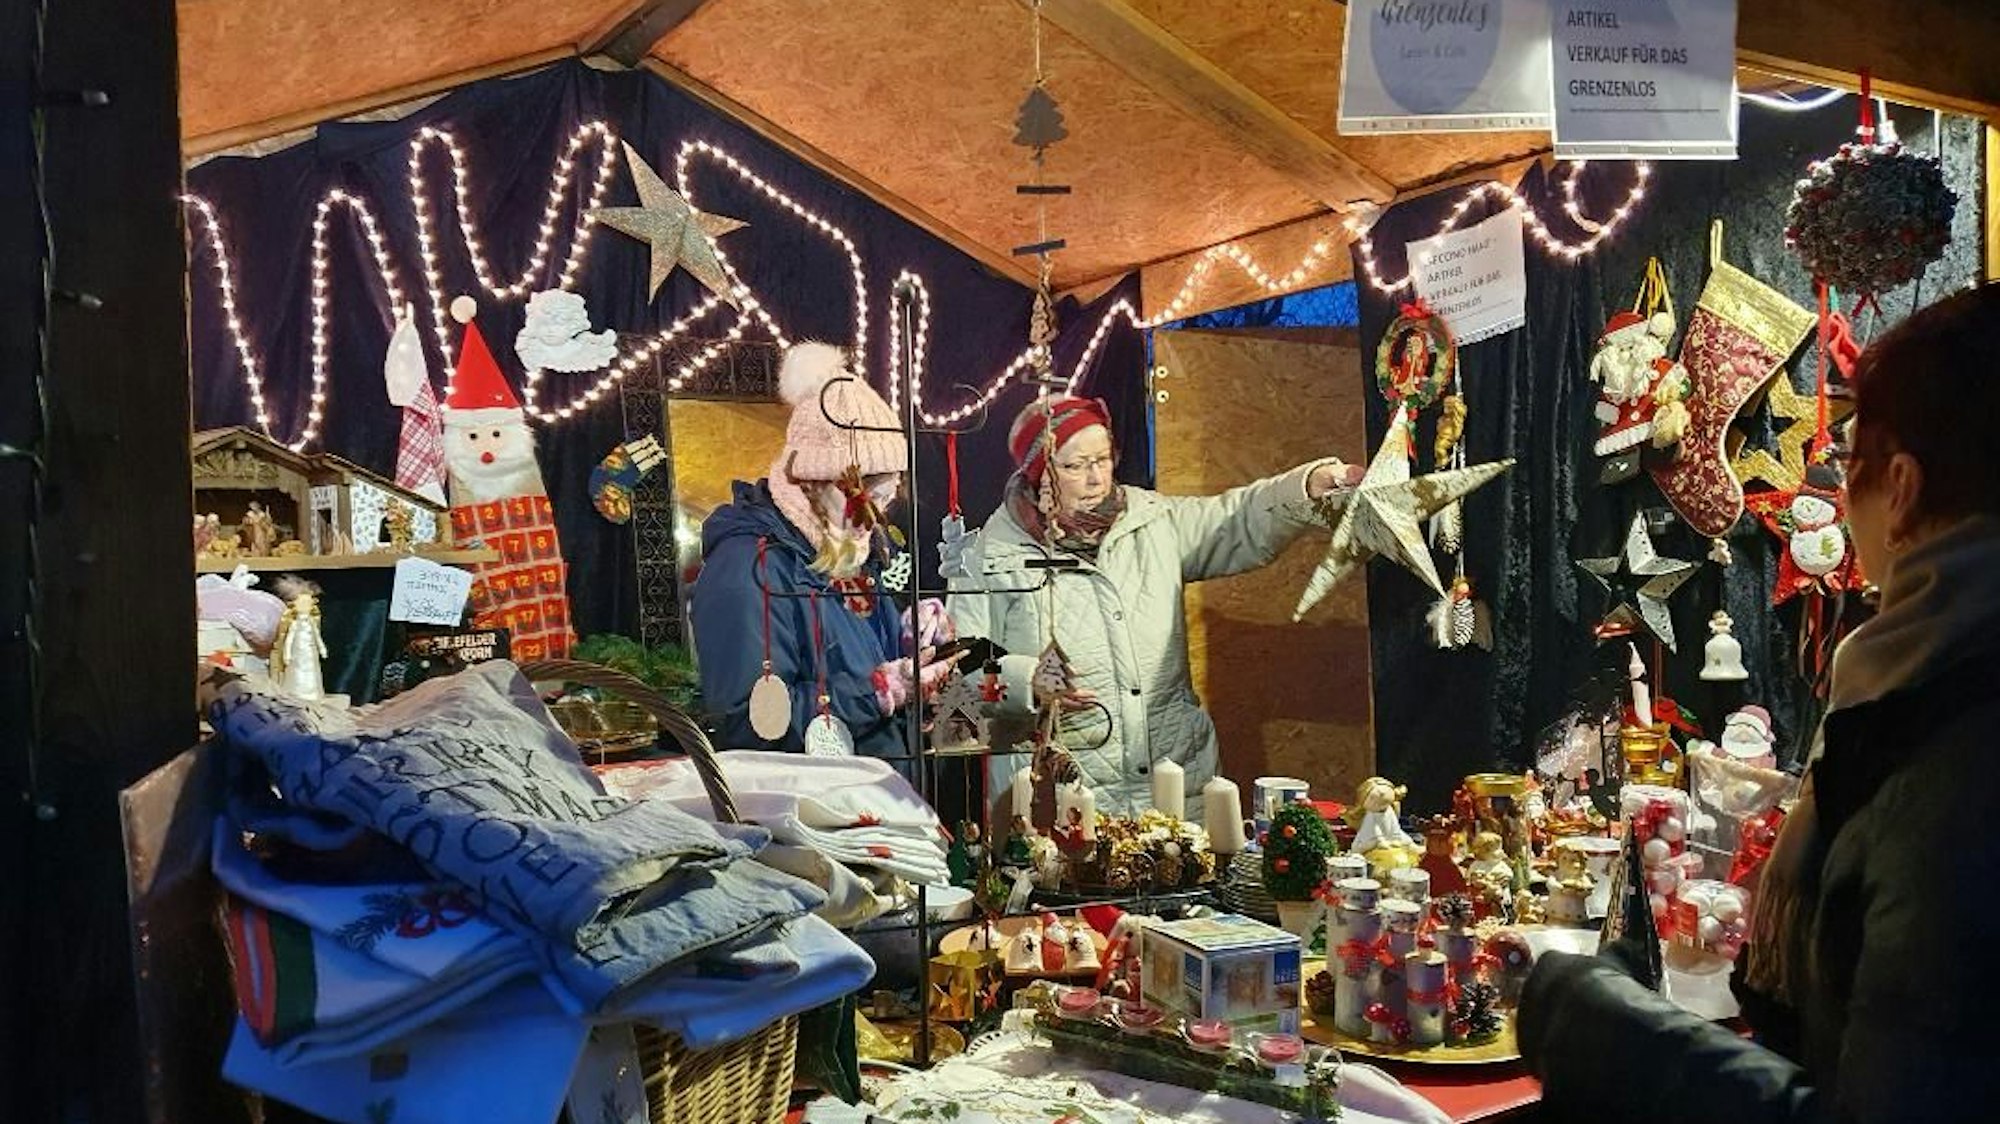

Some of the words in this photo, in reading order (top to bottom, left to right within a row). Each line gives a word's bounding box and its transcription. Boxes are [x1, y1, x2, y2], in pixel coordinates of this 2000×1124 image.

[1567, 10, 1620, 29] ARTIKEL
[1567, 45, 1629, 63] VERKAUF
[1632, 43, 1659, 64] FÜR
[1661, 49, 1688, 64] DAS
[1569, 79, 1657, 97] GRENZENLOS
[459, 513, 468, 525] 1
[484, 507, 495, 520] 2
[515, 503, 525, 516] 3
[509, 539, 520, 549] 7
[536, 536, 547, 549] 8
[515, 574, 530, 587] 12
[541, 569, 556, 583] 13
[521, 609, 535, 623] 17
